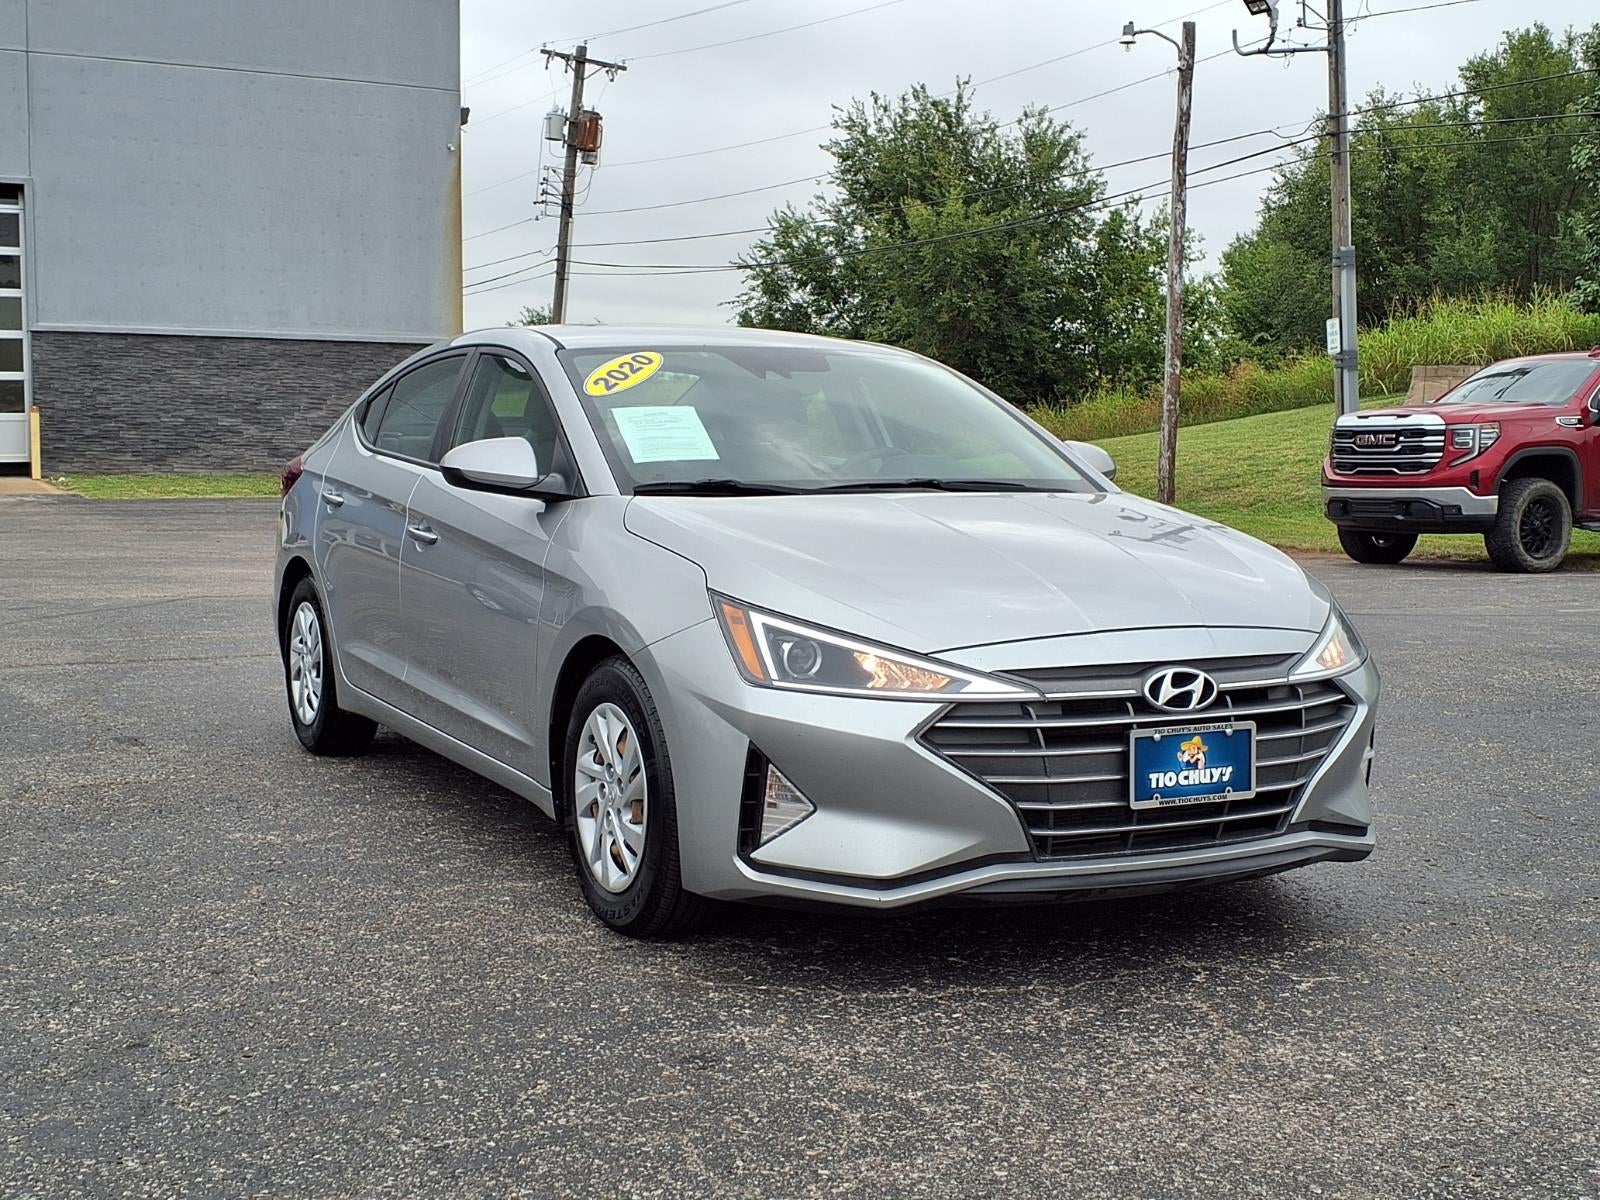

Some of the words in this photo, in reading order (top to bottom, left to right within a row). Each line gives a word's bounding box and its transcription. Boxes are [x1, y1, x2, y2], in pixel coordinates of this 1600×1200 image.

[593, 354, 654, 391] 2020
[1354, 433, 1396, 446] GMC
[1166, 726, 1192, 734] CHUY'S
[1212, 723, 1233, 731] SALES
[1158, 794, 1228, 806] WWW.TIOCHUYS.COM
